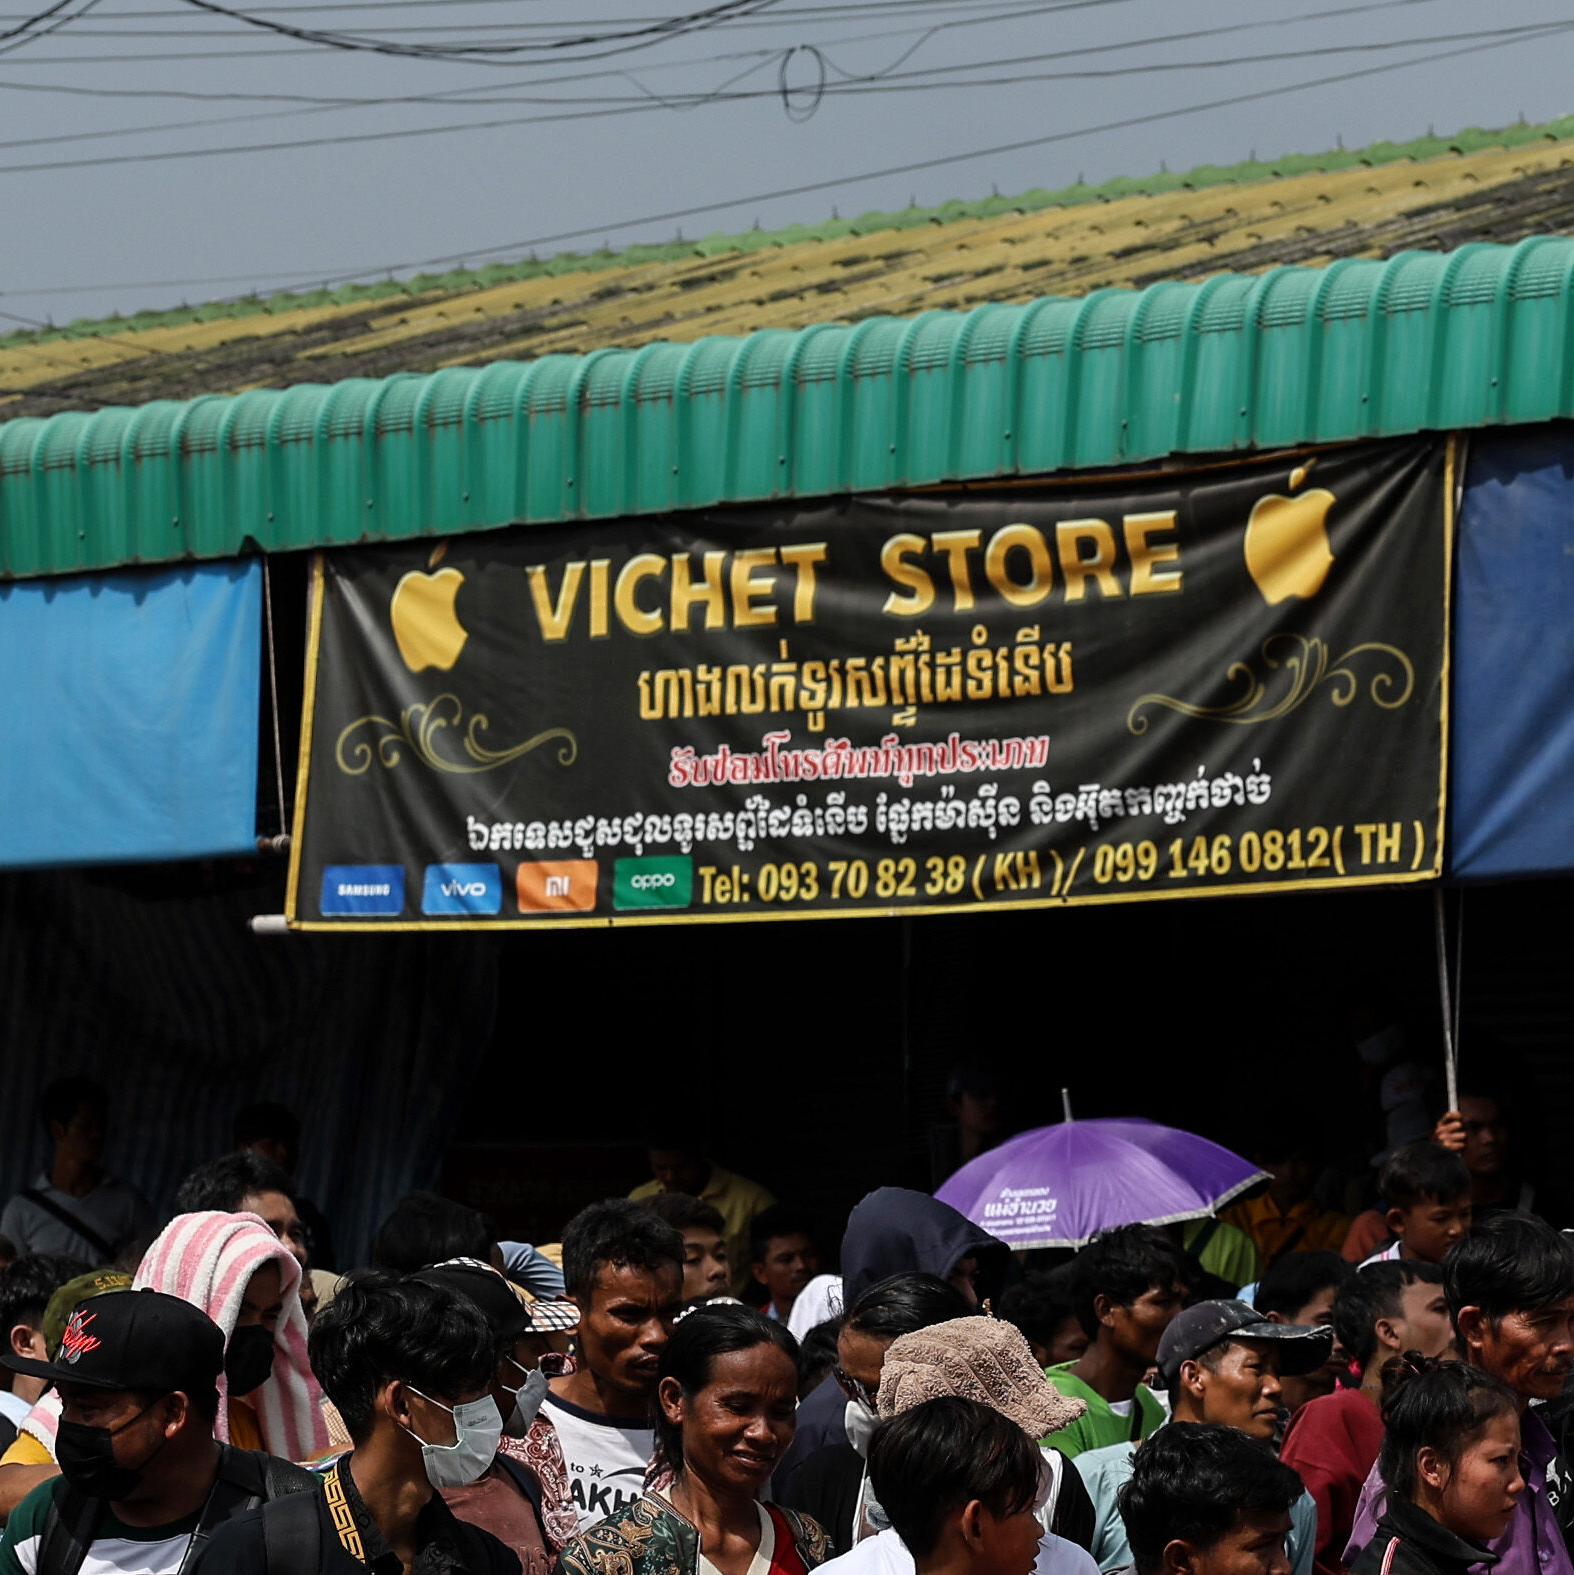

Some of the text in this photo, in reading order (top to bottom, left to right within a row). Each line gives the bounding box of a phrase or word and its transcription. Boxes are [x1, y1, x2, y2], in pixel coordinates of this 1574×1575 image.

[526, 510, 1187, 645] VICHET STORE
[698, 865, 751, 904] Tel:
[757, 861, 819, 902] 093
[828, 859, 868, 899] 70
[874, 858, 917, 897] 82
[924, 855, 966, 894] 38
[993, 852, 1042, 891] KH
[1093, 840, 1157, 885] 099
[1168, 834, 1232, 878] 146
[1356, 825, 1402, 865] TH
[336, 882, 391, 897] SAMSUNG
[570, 1462, 585, 1474] to
